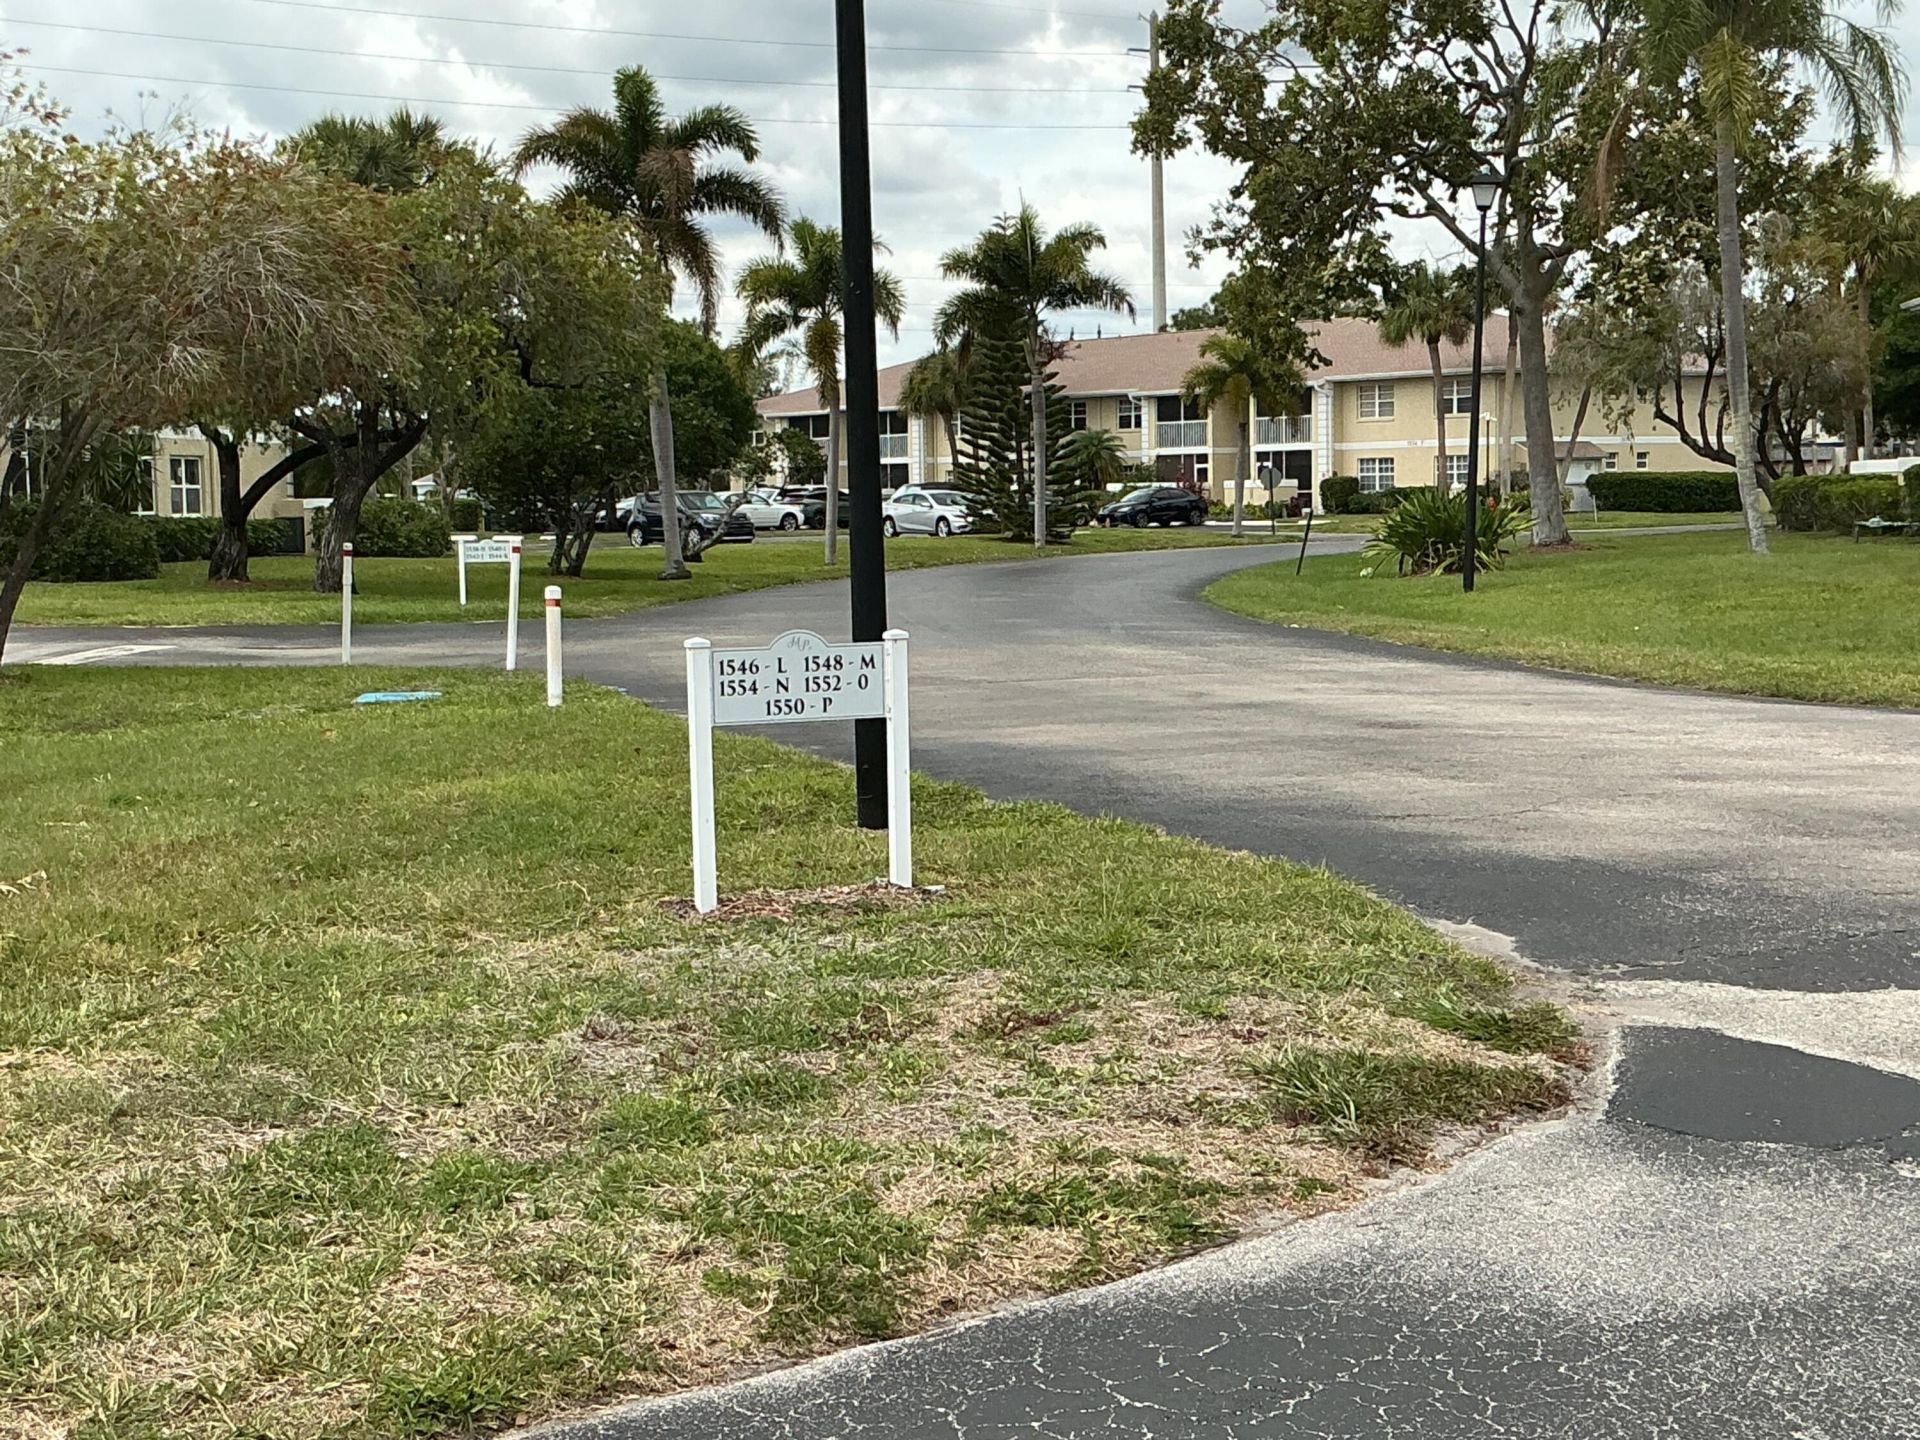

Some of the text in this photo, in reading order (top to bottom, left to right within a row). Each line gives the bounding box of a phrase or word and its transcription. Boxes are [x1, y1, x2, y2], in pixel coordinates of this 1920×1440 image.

[720, 659, 759, 676] 1546
[777, 657, 787, 673] L
[805, 655, 843, 672] 1548
[860, 654, 875, 670] M
[720, 679, 758, 696] 1554
[776, 678, 789, 694] N
[805, 675, 841, 692] 1552
[766, 698, 804, 716] 1550
[823, 697, 832, 713] P
